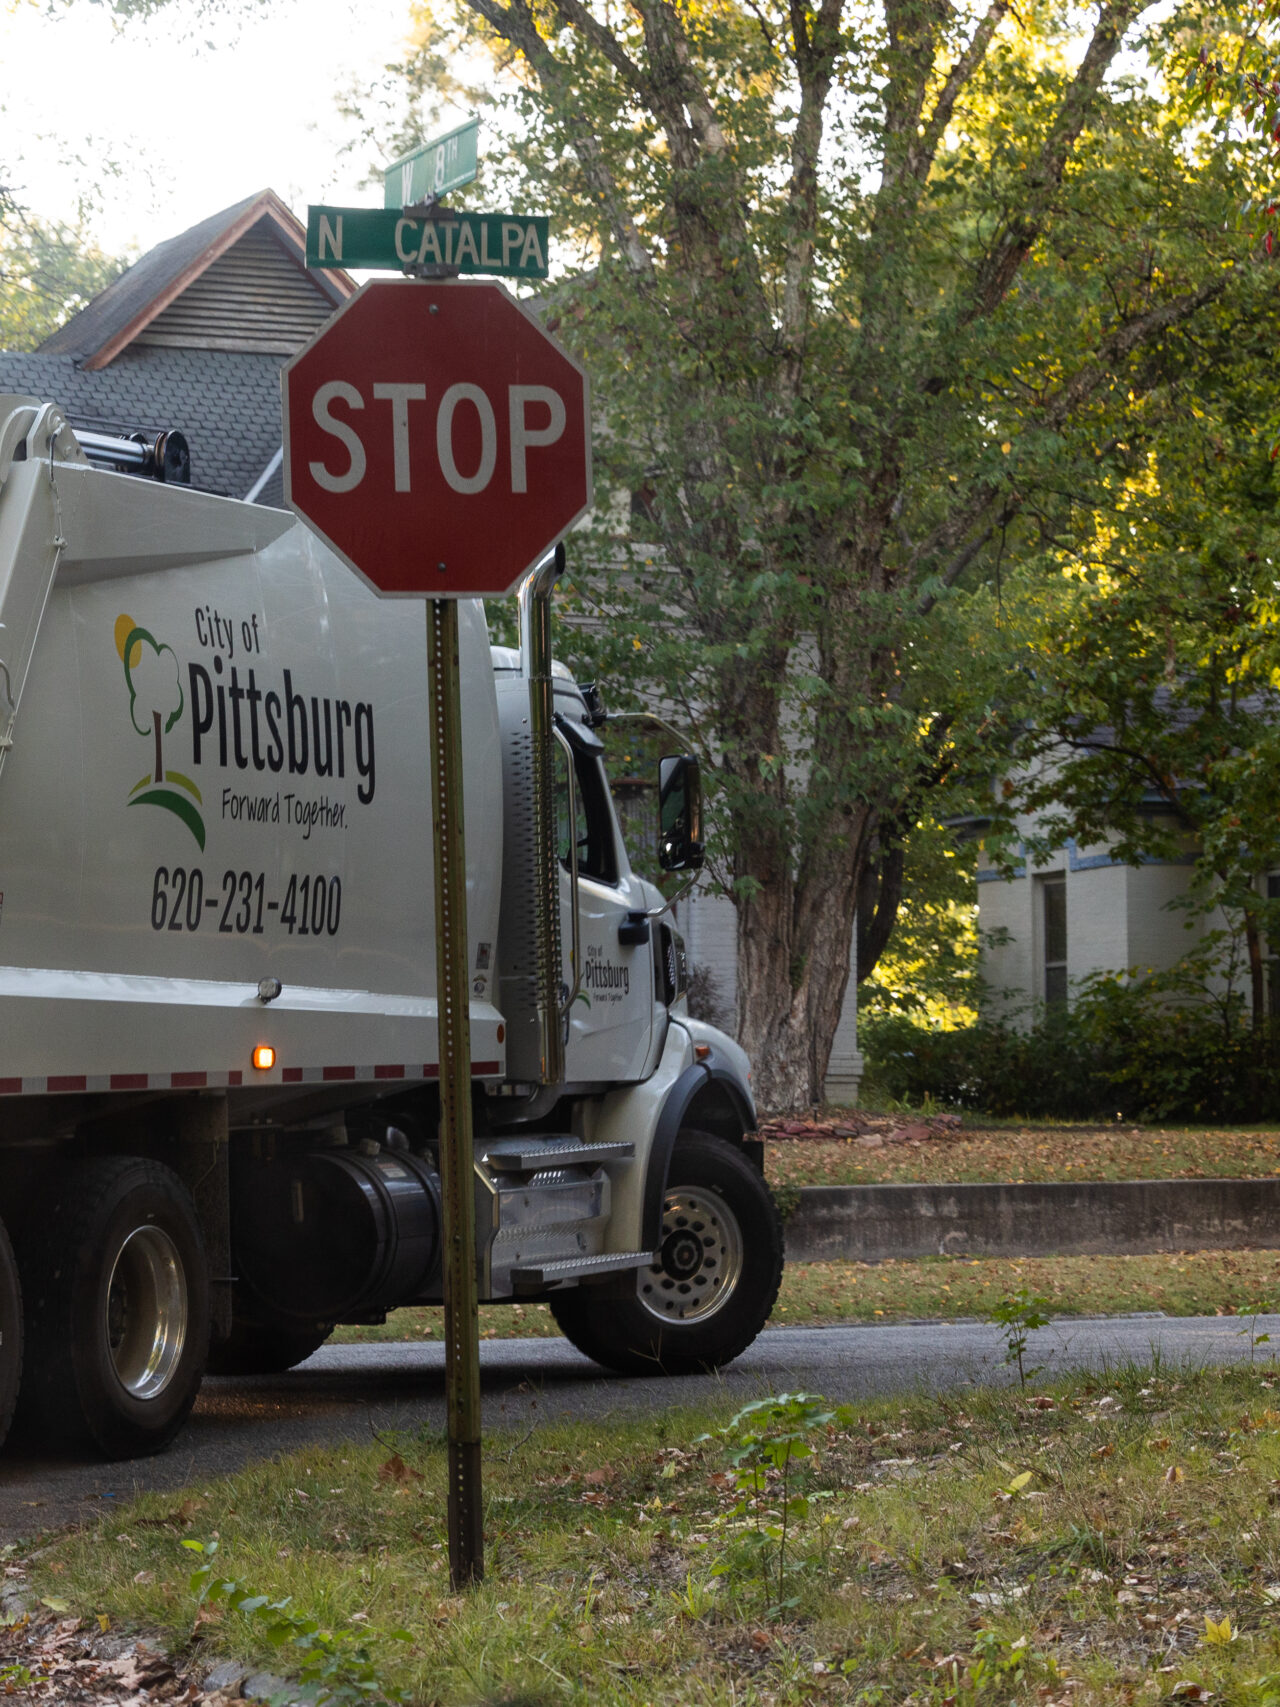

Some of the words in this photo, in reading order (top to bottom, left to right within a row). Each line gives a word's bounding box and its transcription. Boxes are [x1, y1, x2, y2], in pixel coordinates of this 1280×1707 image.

[401, 159, 414, 206] W
[434, 135, 458, 188] 8TH
[318, 214, 343, 261] N
[394, 218, 545, 269] CATALPA
[308, 380, 567, 494] STOP
[195, 605, 234, 660] City
[241, 613, 260, 654] of
[188, 655, 376, 805] Pittsburg
[222, 787, 280, 823] Forward
[284, 793, 348, 840] Together.
[151, 866, 342, 936] 620-231-4100
[585, 958, 629, 995] Pittsburg
